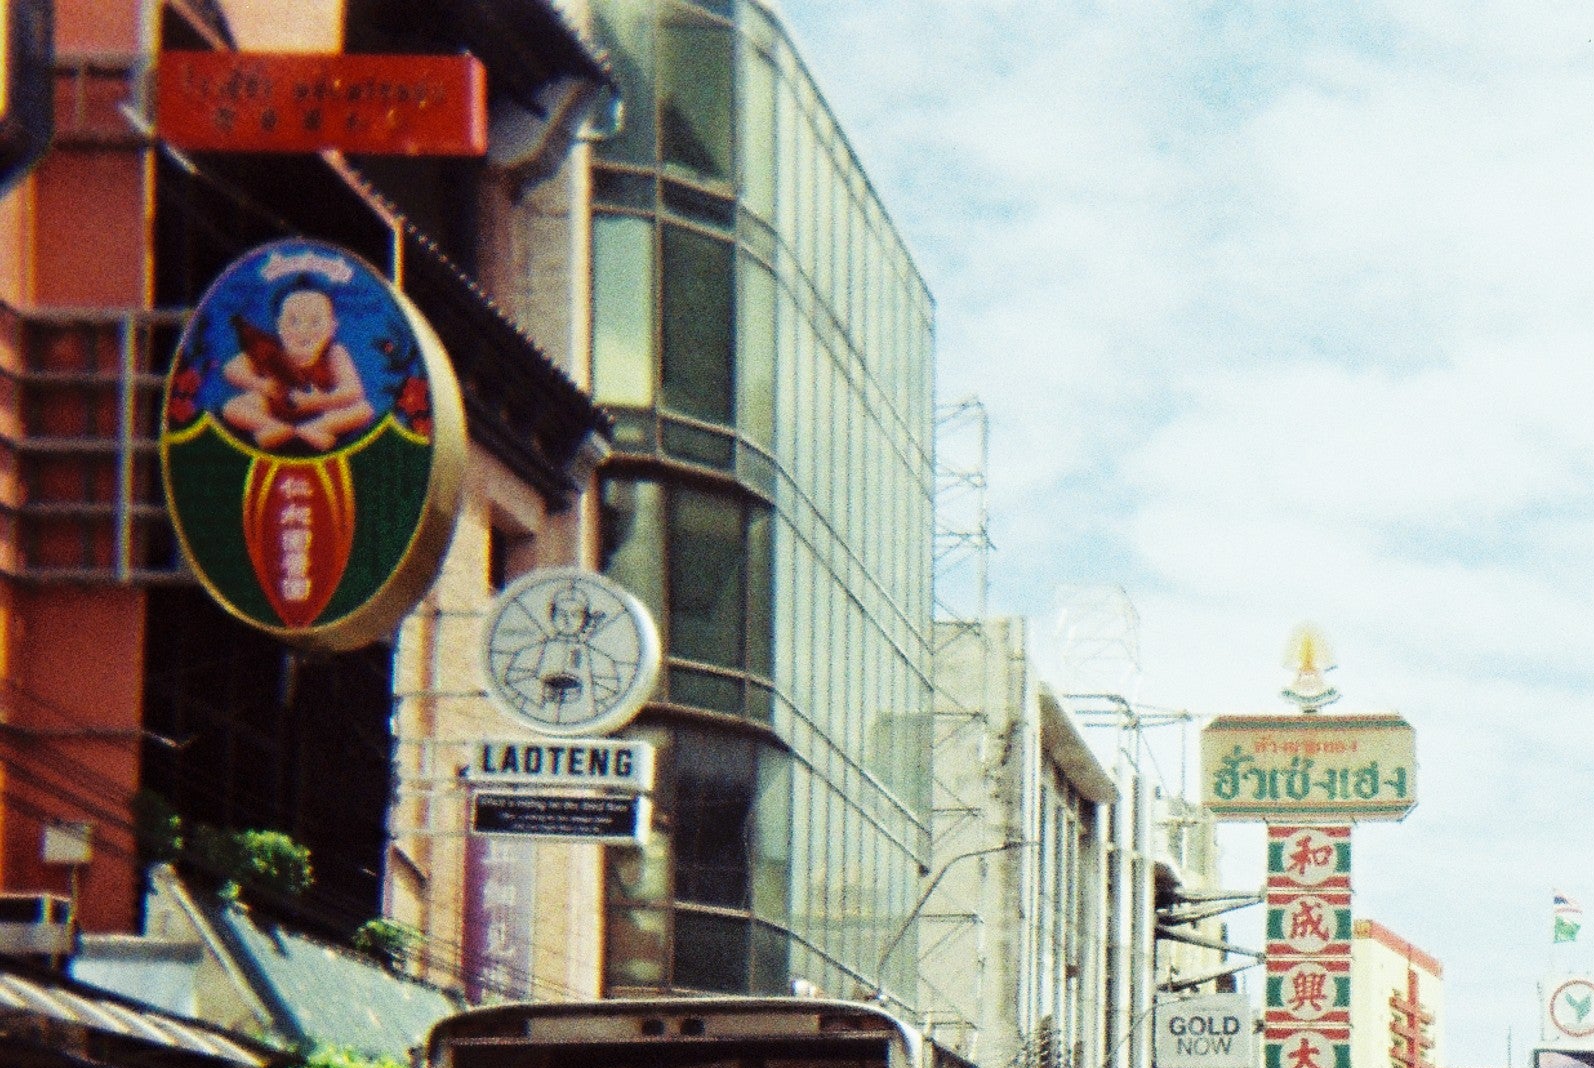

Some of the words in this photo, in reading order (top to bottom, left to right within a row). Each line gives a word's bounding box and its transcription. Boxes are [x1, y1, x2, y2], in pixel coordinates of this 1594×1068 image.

[480, 743, 635, 778] LAOTENG
[1168, 1015, 1241, 1037] GOLD
[1176, 1037, 1233, 1056] NOW
